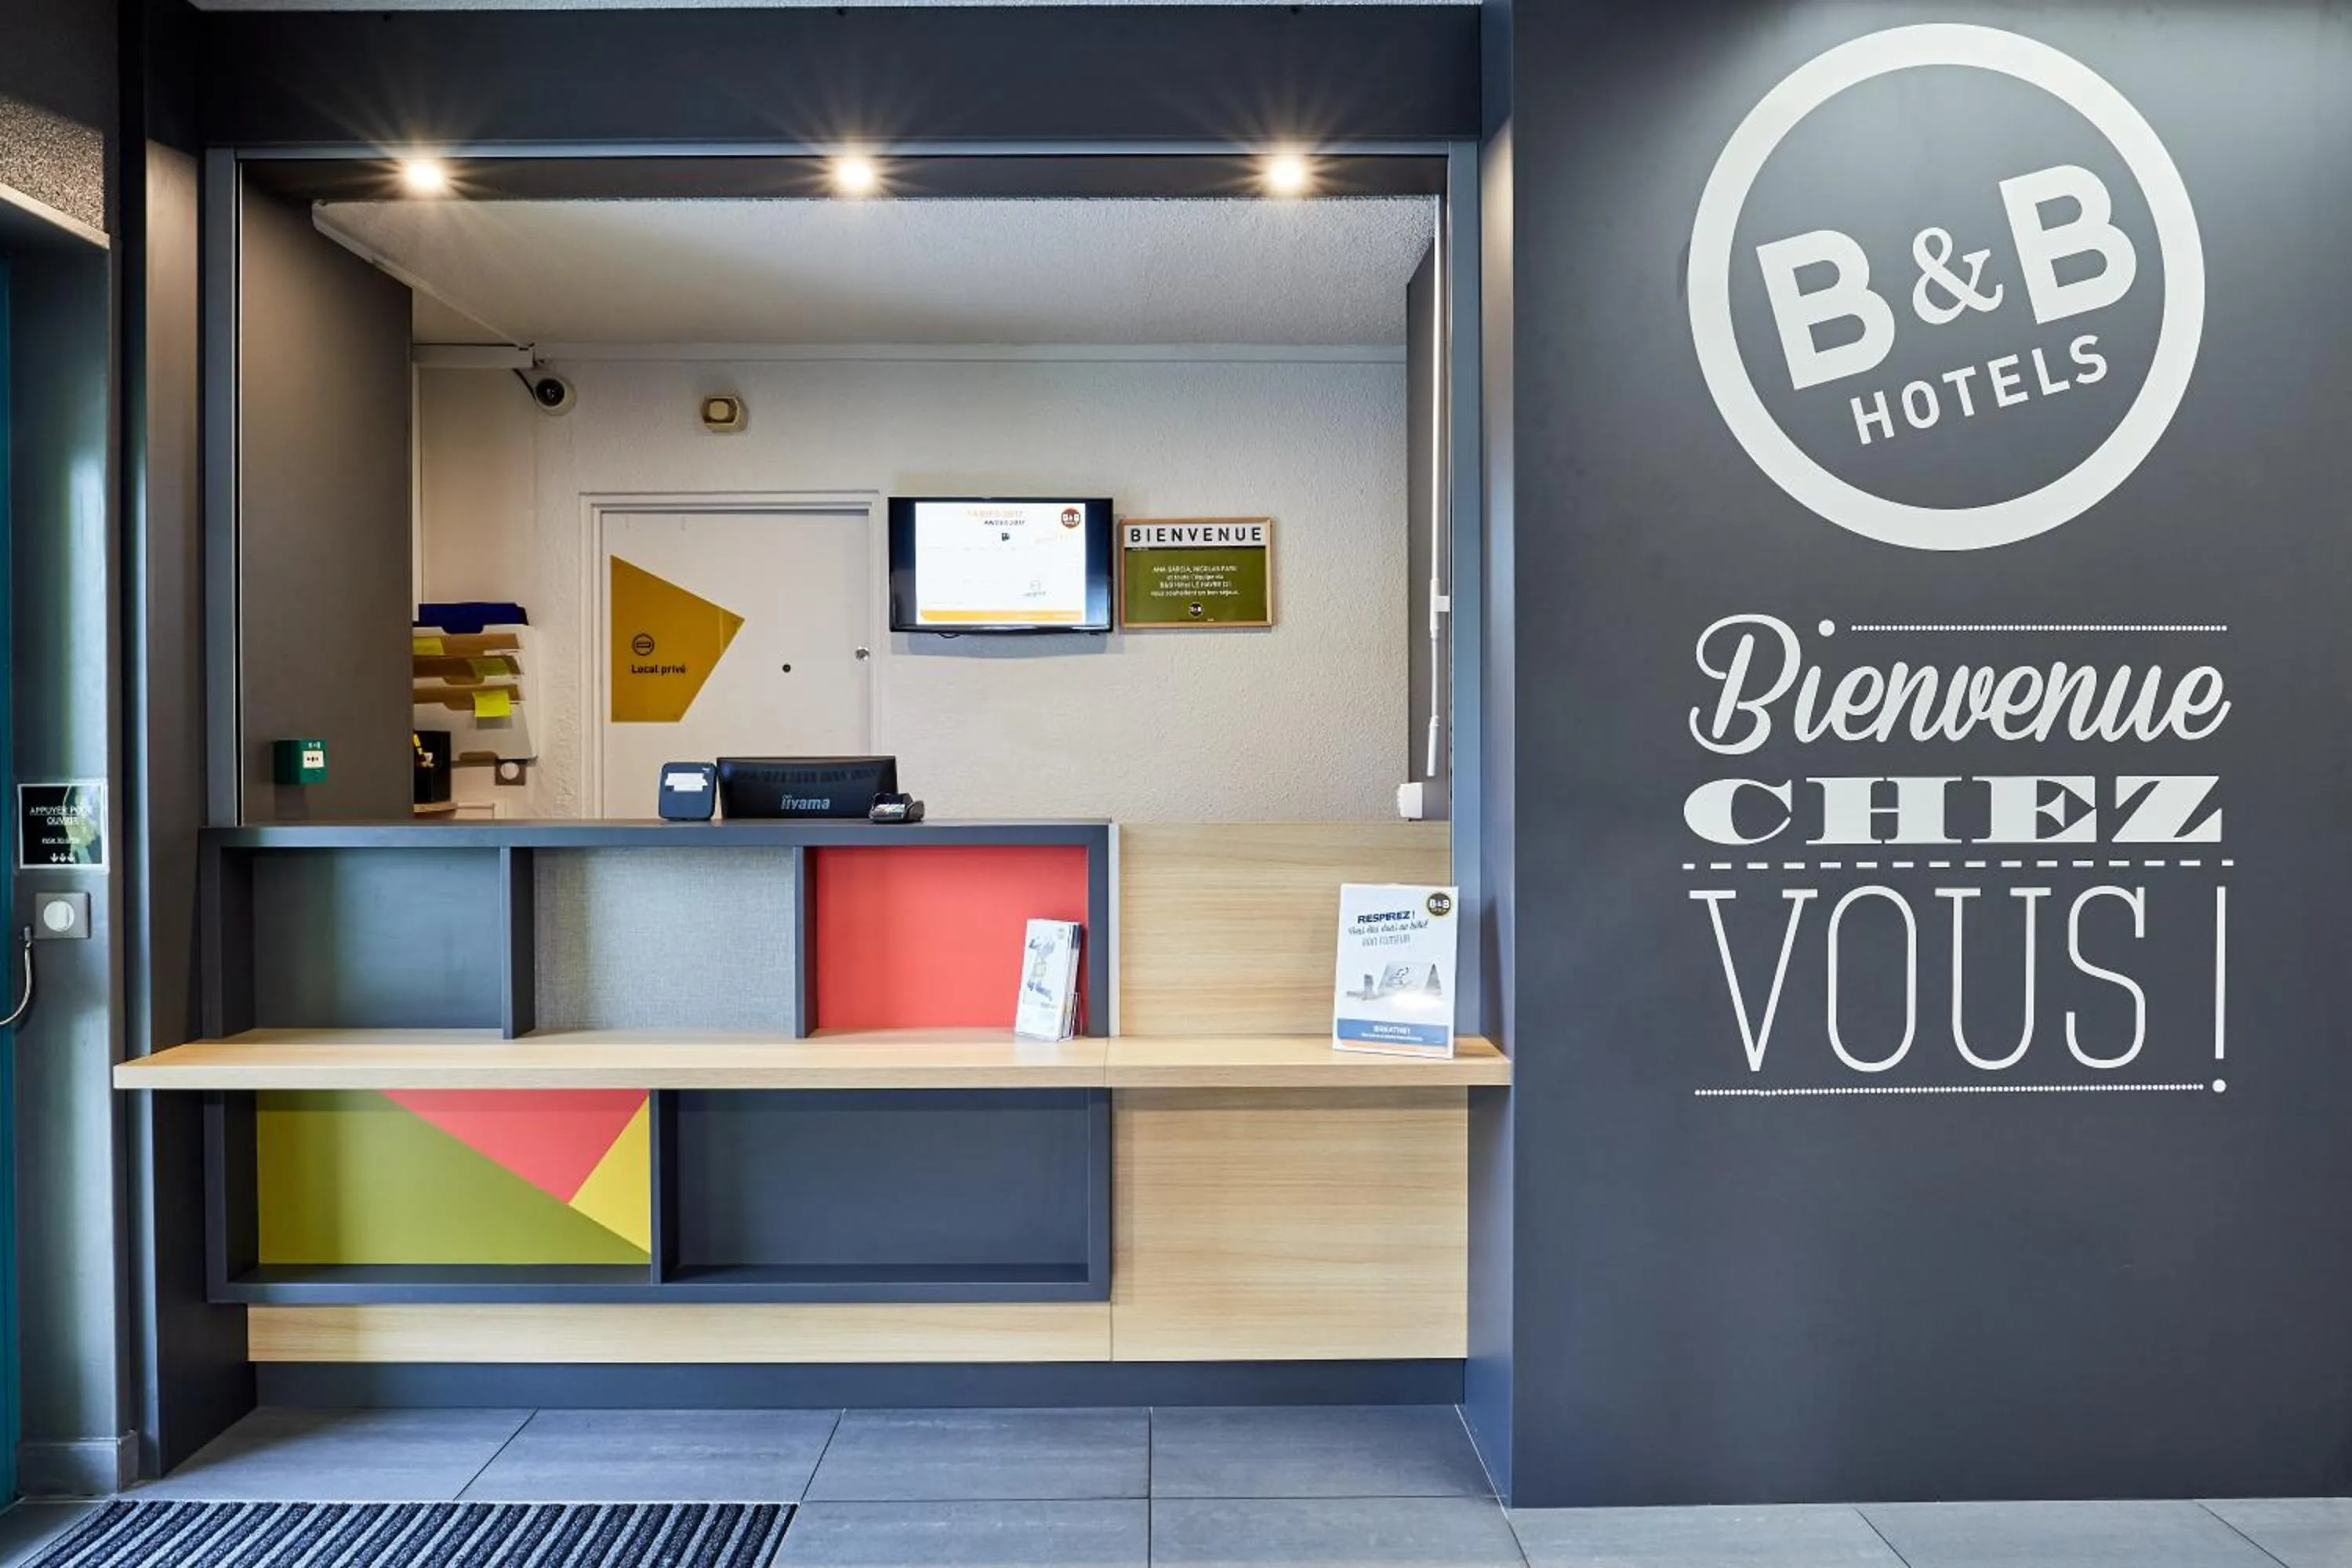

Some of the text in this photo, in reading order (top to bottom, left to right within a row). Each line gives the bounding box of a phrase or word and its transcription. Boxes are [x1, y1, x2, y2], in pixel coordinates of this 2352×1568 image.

[1850, 335, 2107, 445] HOTELS
[1131, 527, 1261, 543] BIENVENUE
[631, 664, 686, 677] Local privé
[1689, 614, 2232, 755] Bienvenue
[780, 794, 831, 810] iiyama
[1683, 775, 2223, 846] CHEZ
